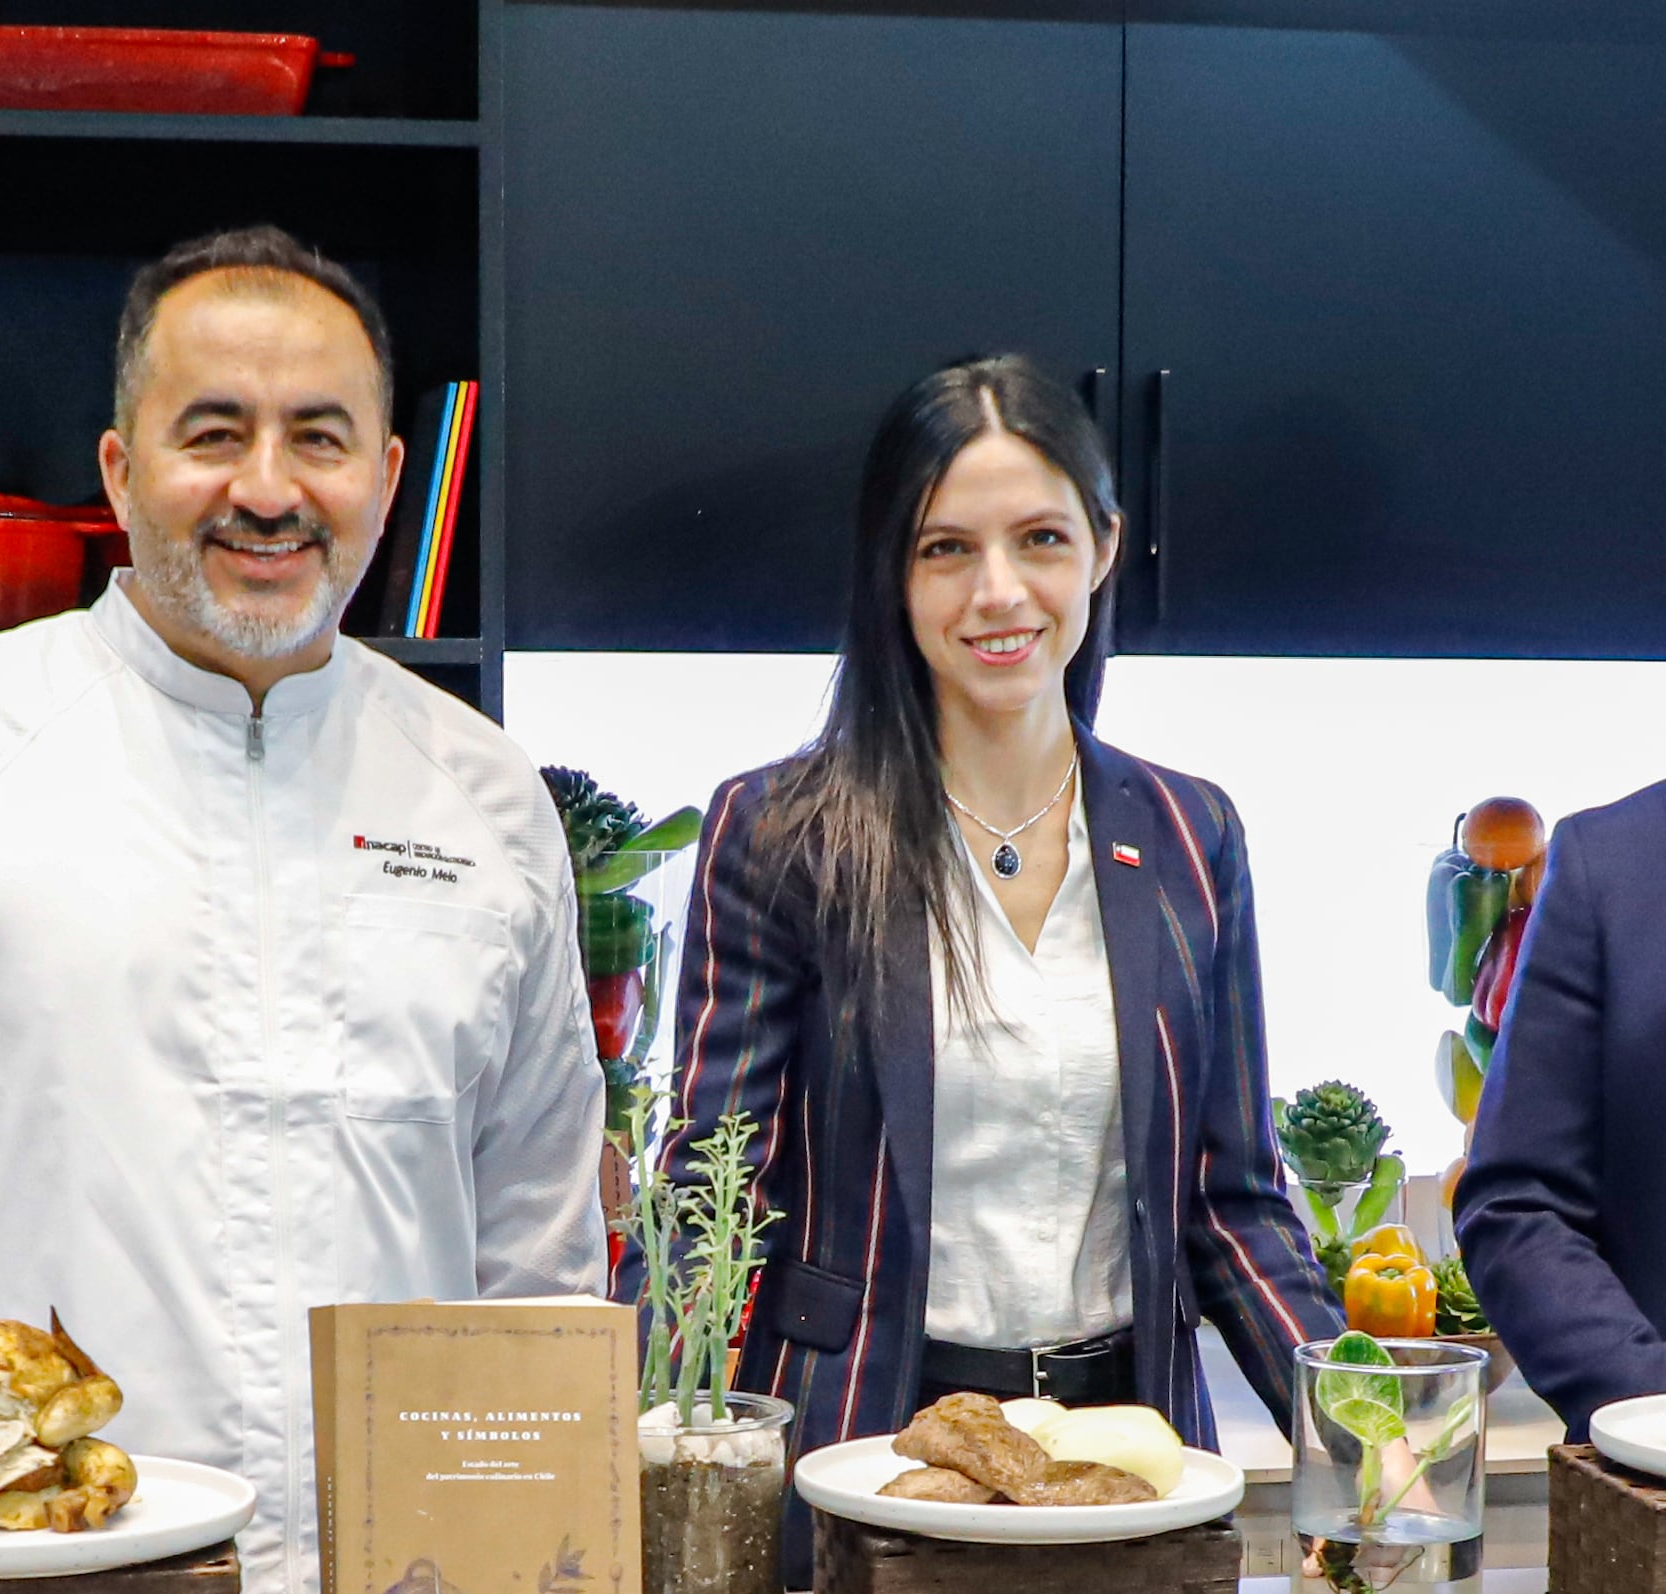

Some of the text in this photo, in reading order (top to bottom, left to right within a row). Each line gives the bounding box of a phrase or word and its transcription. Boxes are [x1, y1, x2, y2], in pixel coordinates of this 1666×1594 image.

[383, 860, 427, 878] Eugenio
[398, 1411, 582, 1423] COCINAS, ALIMENTOS
[440, 1428, 541, 1441] Y SÍMBOLOS
